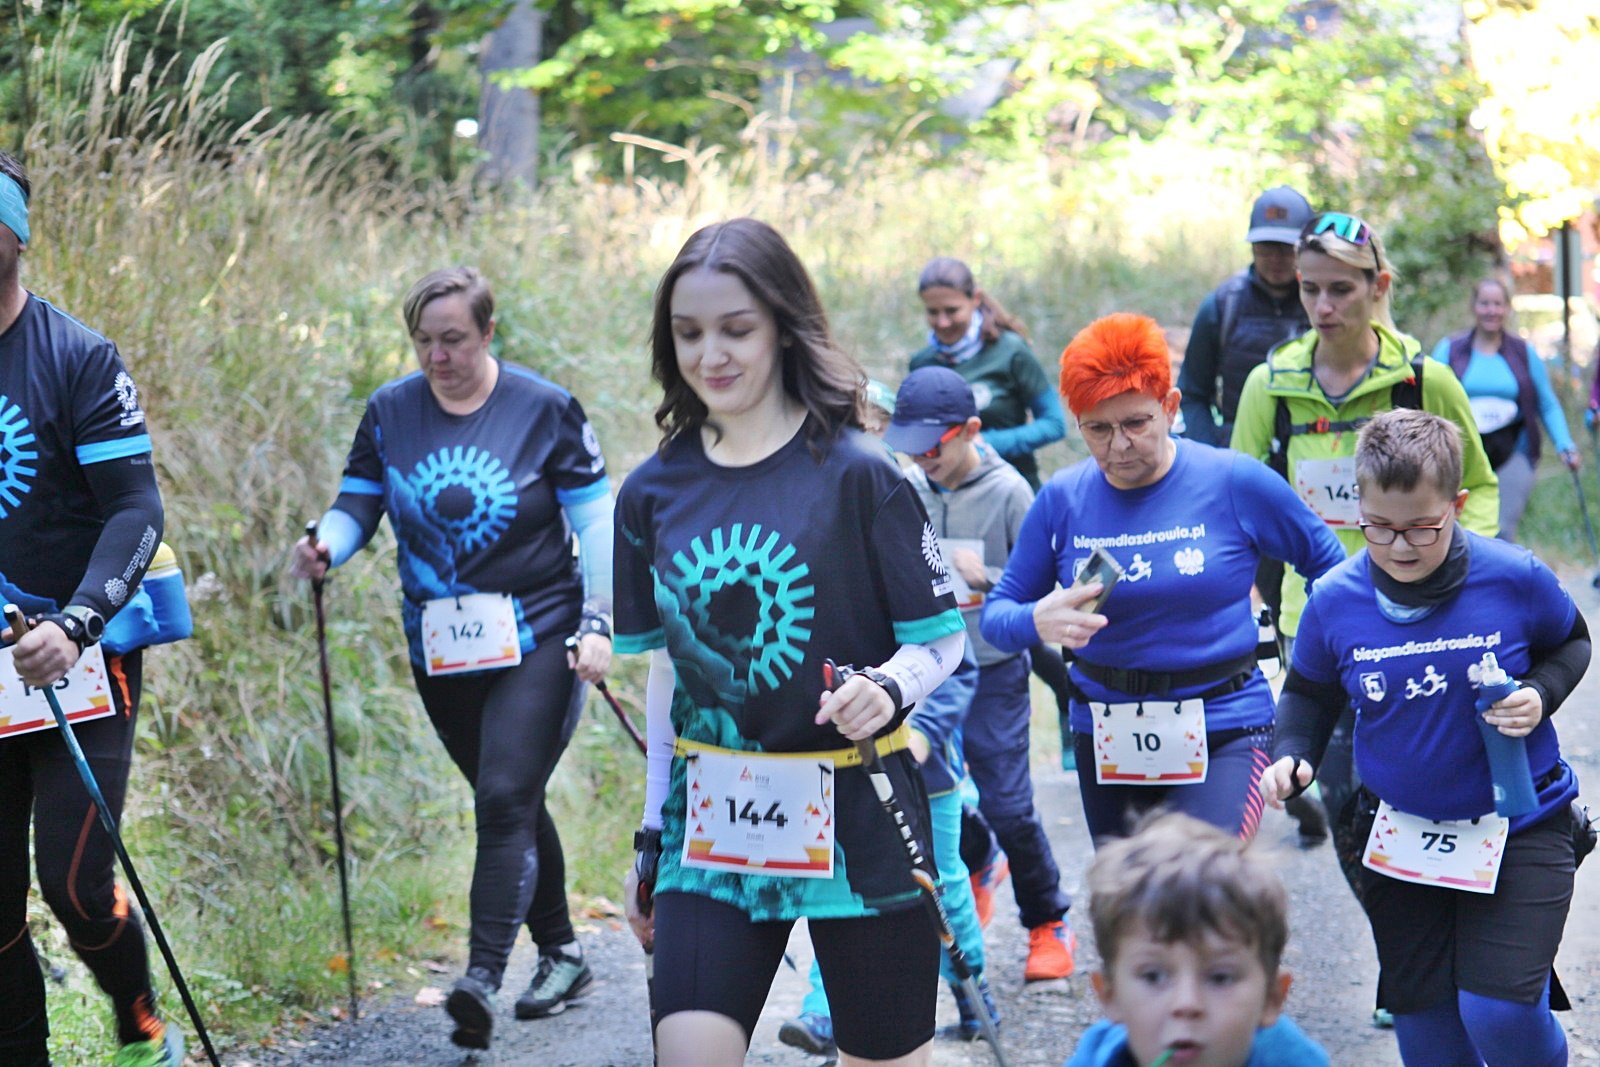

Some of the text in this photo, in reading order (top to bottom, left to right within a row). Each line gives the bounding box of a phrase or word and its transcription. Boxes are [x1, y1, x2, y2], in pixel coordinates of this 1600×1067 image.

[1073, 523, 1206, 550] biegamdlazdrowia.pl
[449, 622, 486, 642] 142
[1353, 631, 1501, 662] biegamdlazdrowia.pl
[1132, 732, 1161, 752] 10
[725, 795, 788, 828] 144
[1421, 831, 1458, 853] 75
